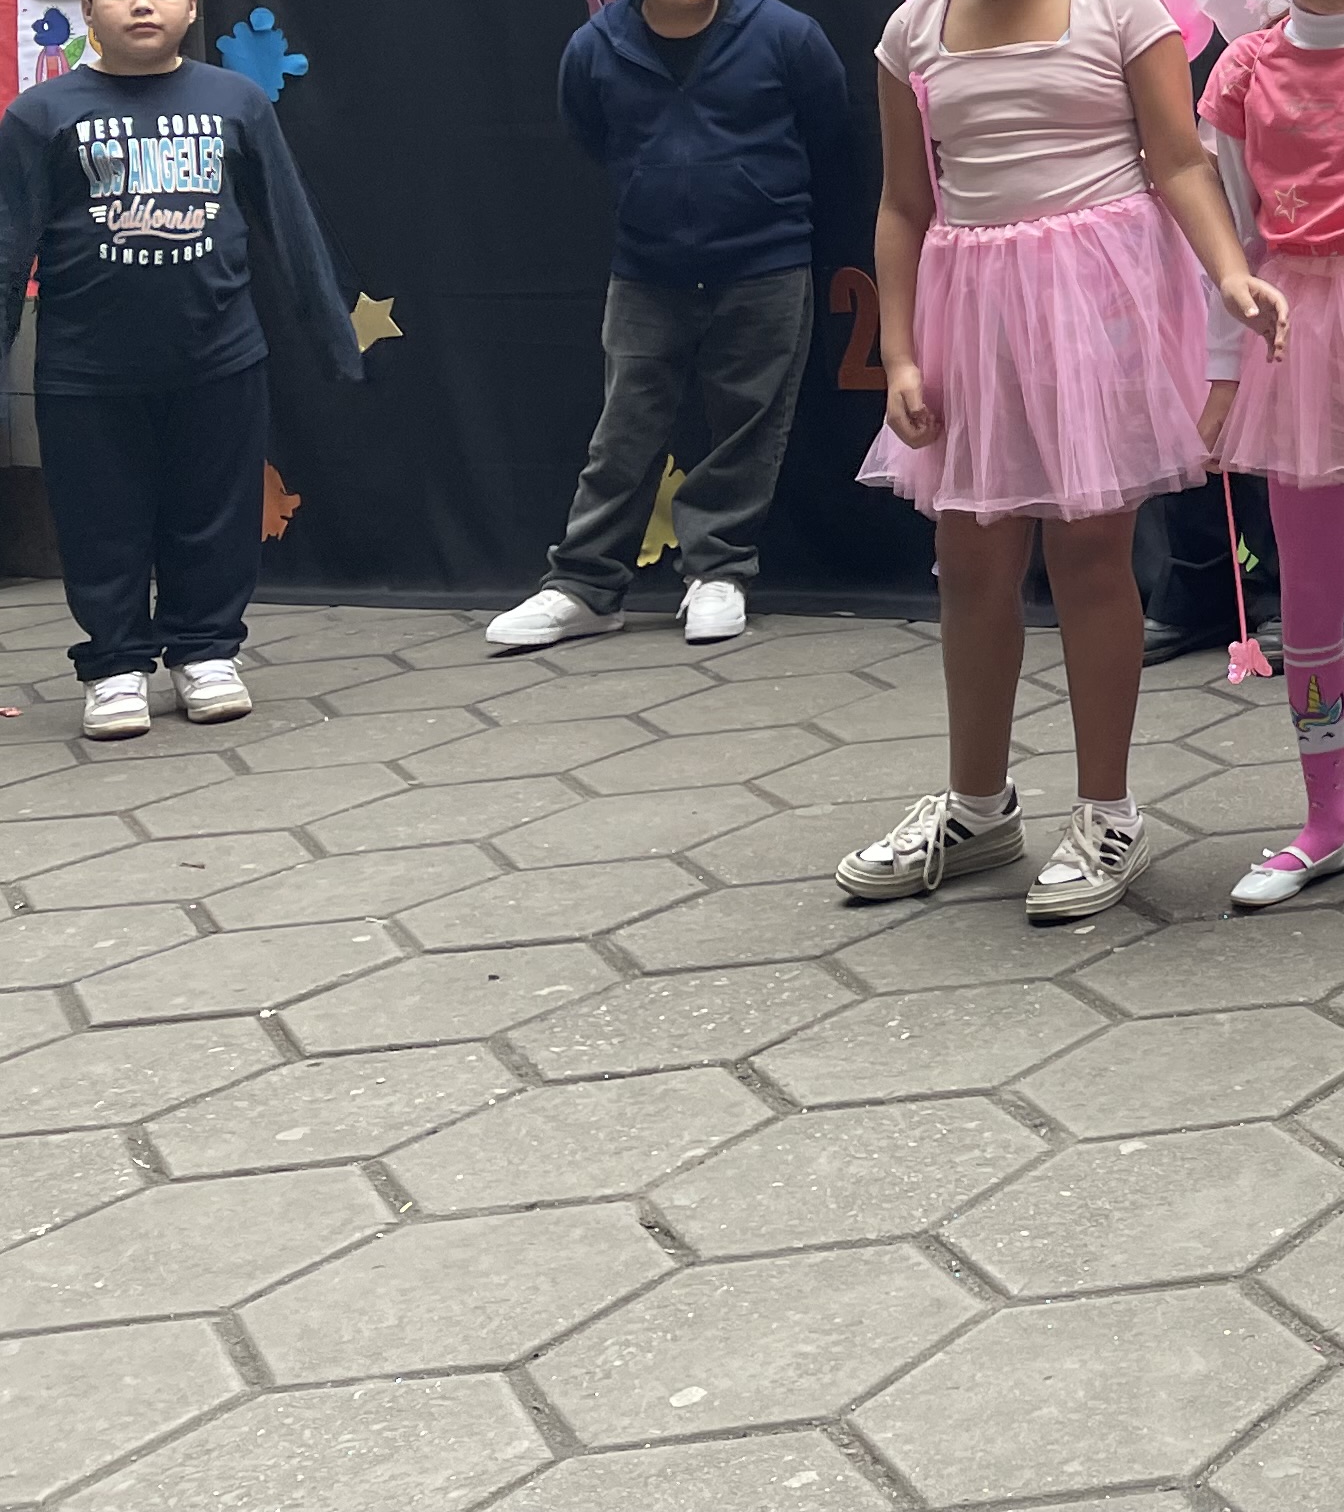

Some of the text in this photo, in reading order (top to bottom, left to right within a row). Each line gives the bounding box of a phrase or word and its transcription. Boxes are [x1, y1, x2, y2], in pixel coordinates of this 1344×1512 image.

[76, 114, 223, 142] WEST COAST
[78, 136, 224, 198] LOS ANGELES
[107, 195, 206, 234] California
[100, 243, 164, 265] SINCE
